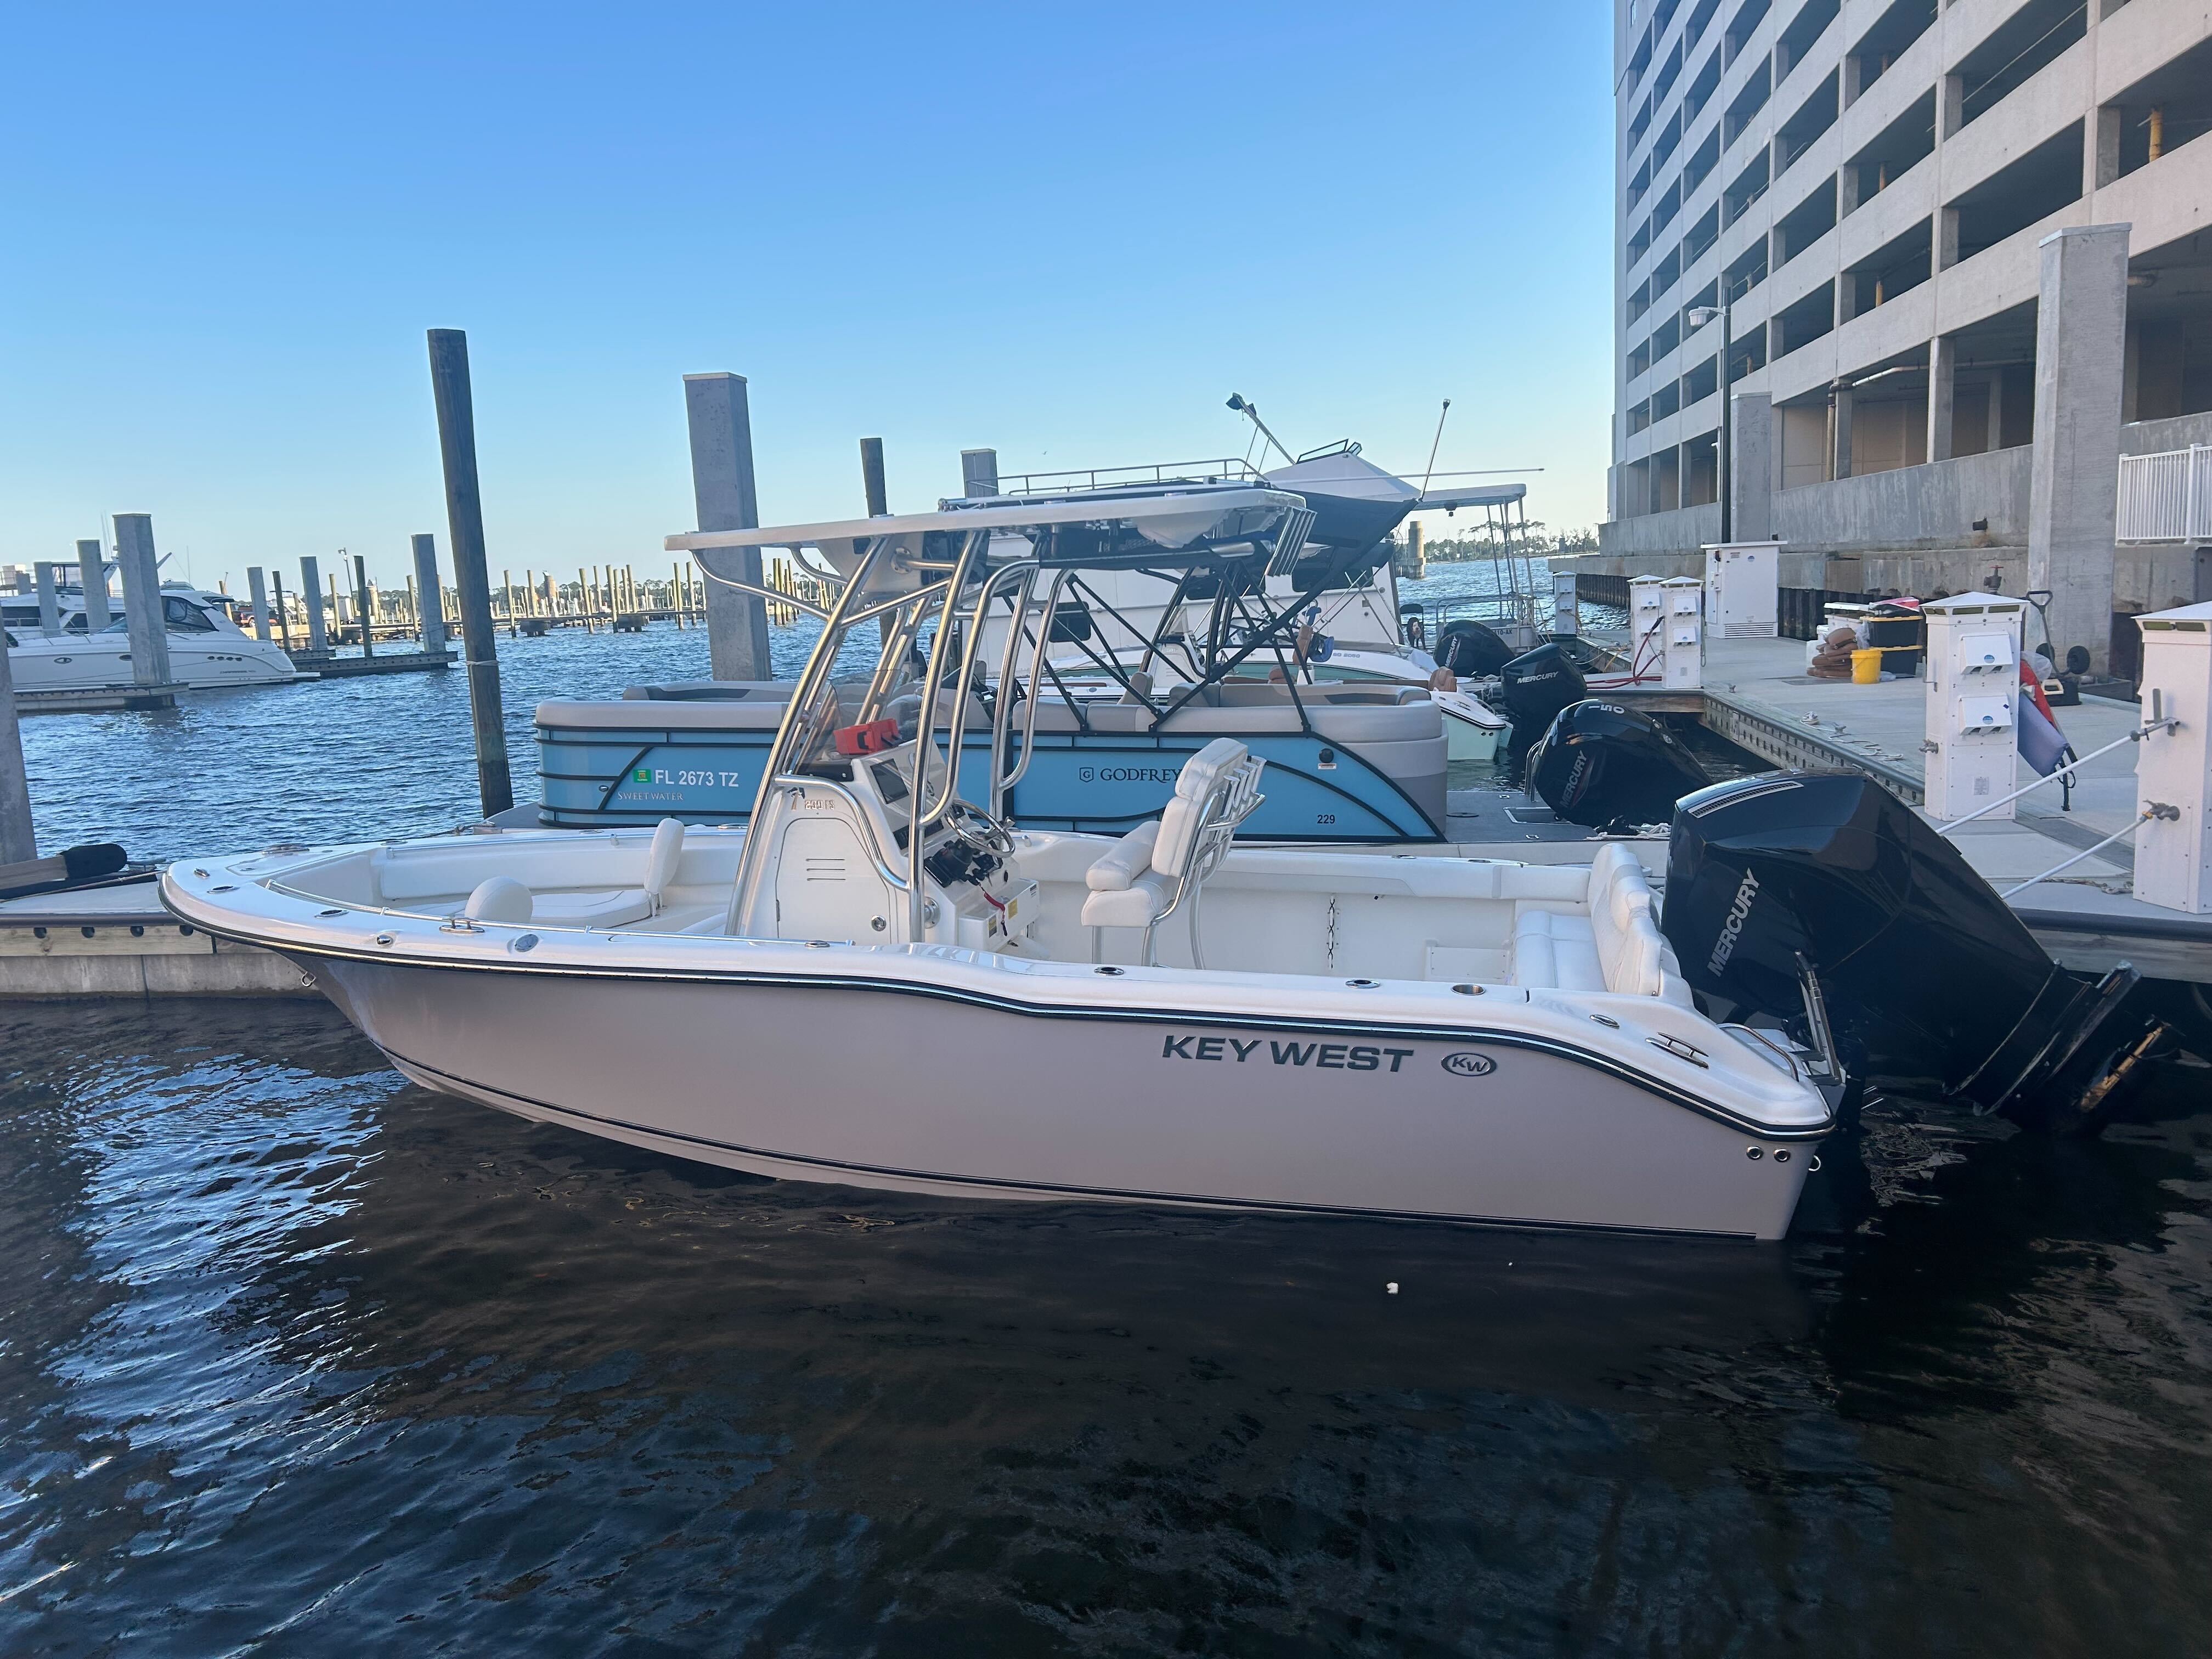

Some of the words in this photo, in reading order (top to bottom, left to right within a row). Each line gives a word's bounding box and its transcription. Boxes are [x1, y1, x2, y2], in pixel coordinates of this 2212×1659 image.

[1444, 636, 1458, 668] MERCURY
[1516, 671, 1559, 684] MERCURY
[1588, 704, 1624, 714] 150
[655, 770, 674, 785] FL
[679, 770, 714, 786] 2673
[719, 772, 739, 787] TZ
[1559, 750, 1587, 809] MERCURY
[1317, 815, 1335, 824] 229
[1707, 867, 1760, 977] MERCURY
[1162, 1035, 1262, 1062] KEY
[1270, 1041, 1414, 1072] WEST
[1451, 1056, 1488, 1073] KW
